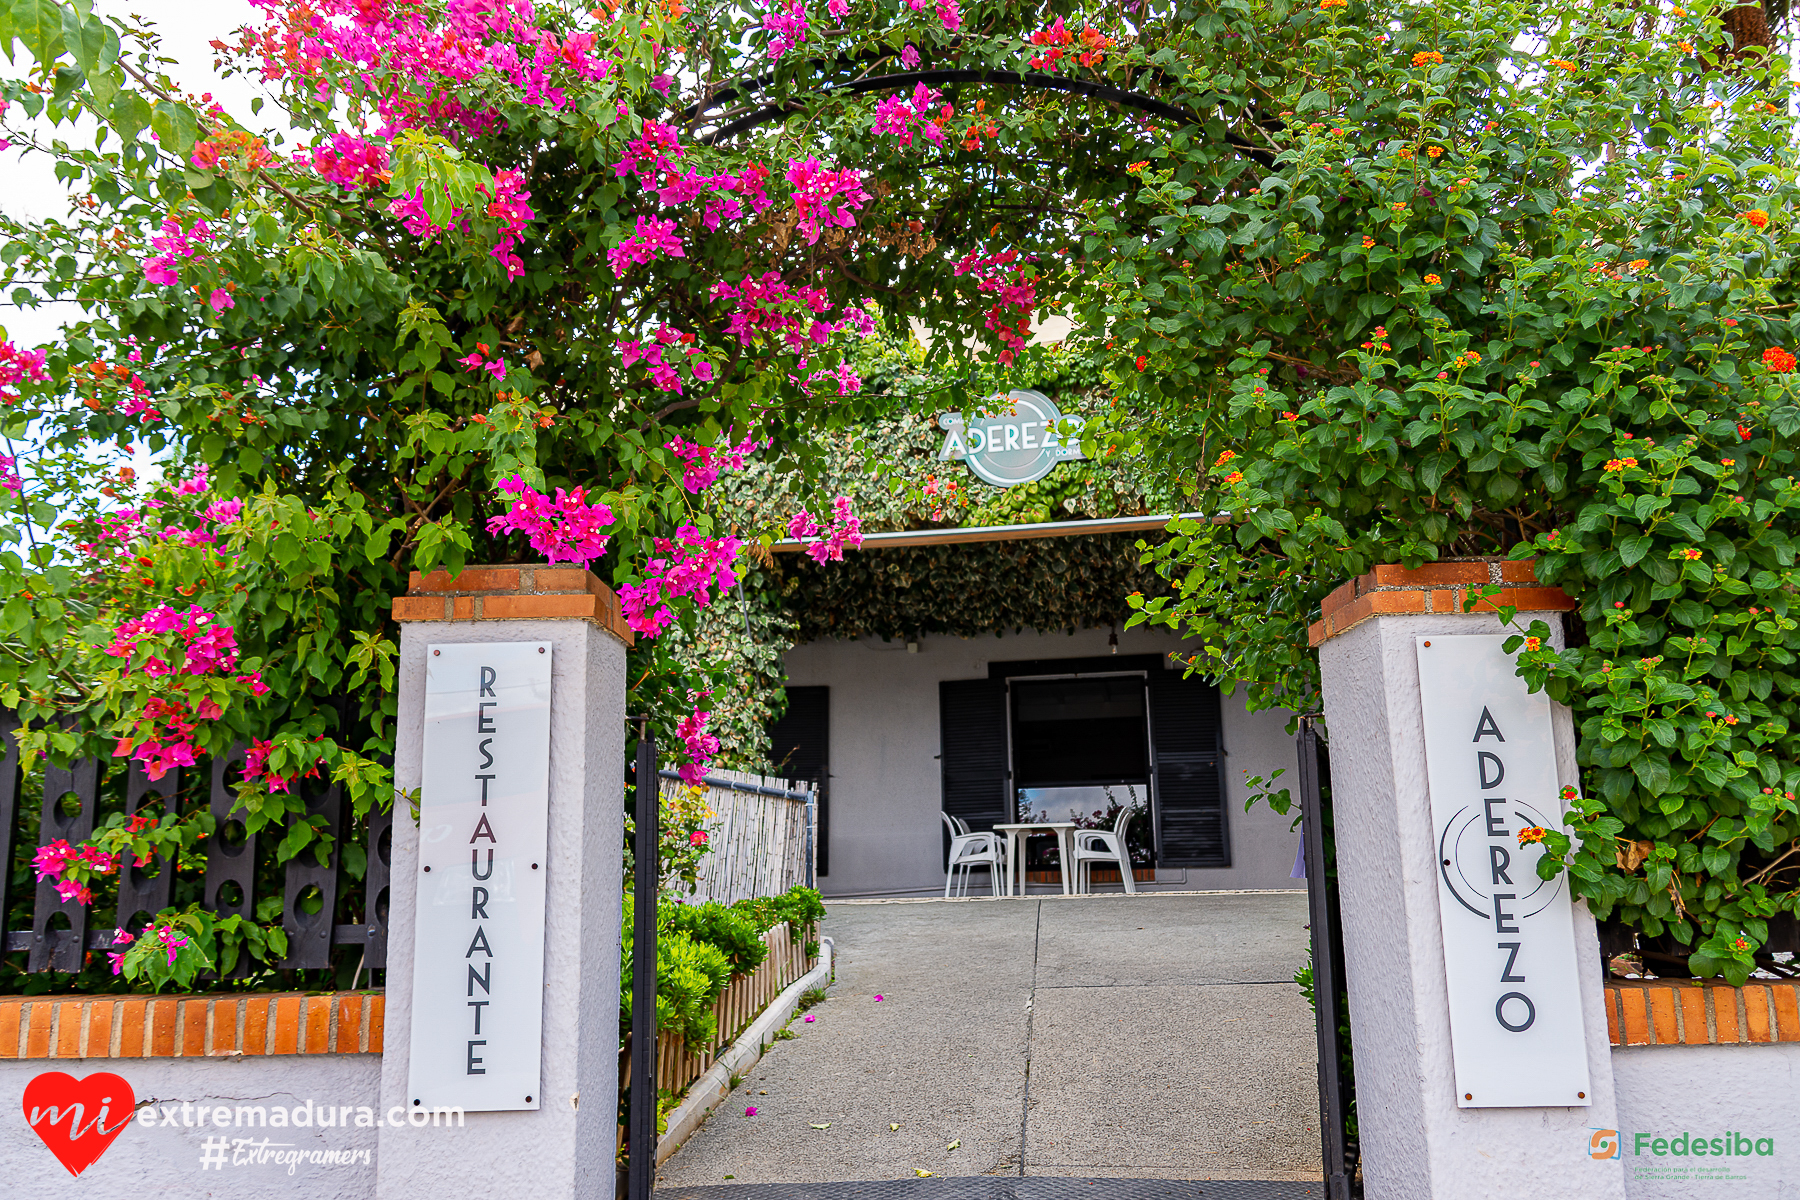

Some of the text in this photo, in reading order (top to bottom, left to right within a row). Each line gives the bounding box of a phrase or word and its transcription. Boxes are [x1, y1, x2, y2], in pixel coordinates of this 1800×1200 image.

[1045, 446, 1081, 458] Y DORM
[465, 666, 497, 1076] RESTAURANTE
[1472, 705, 1536, 1033] ADEREZO
